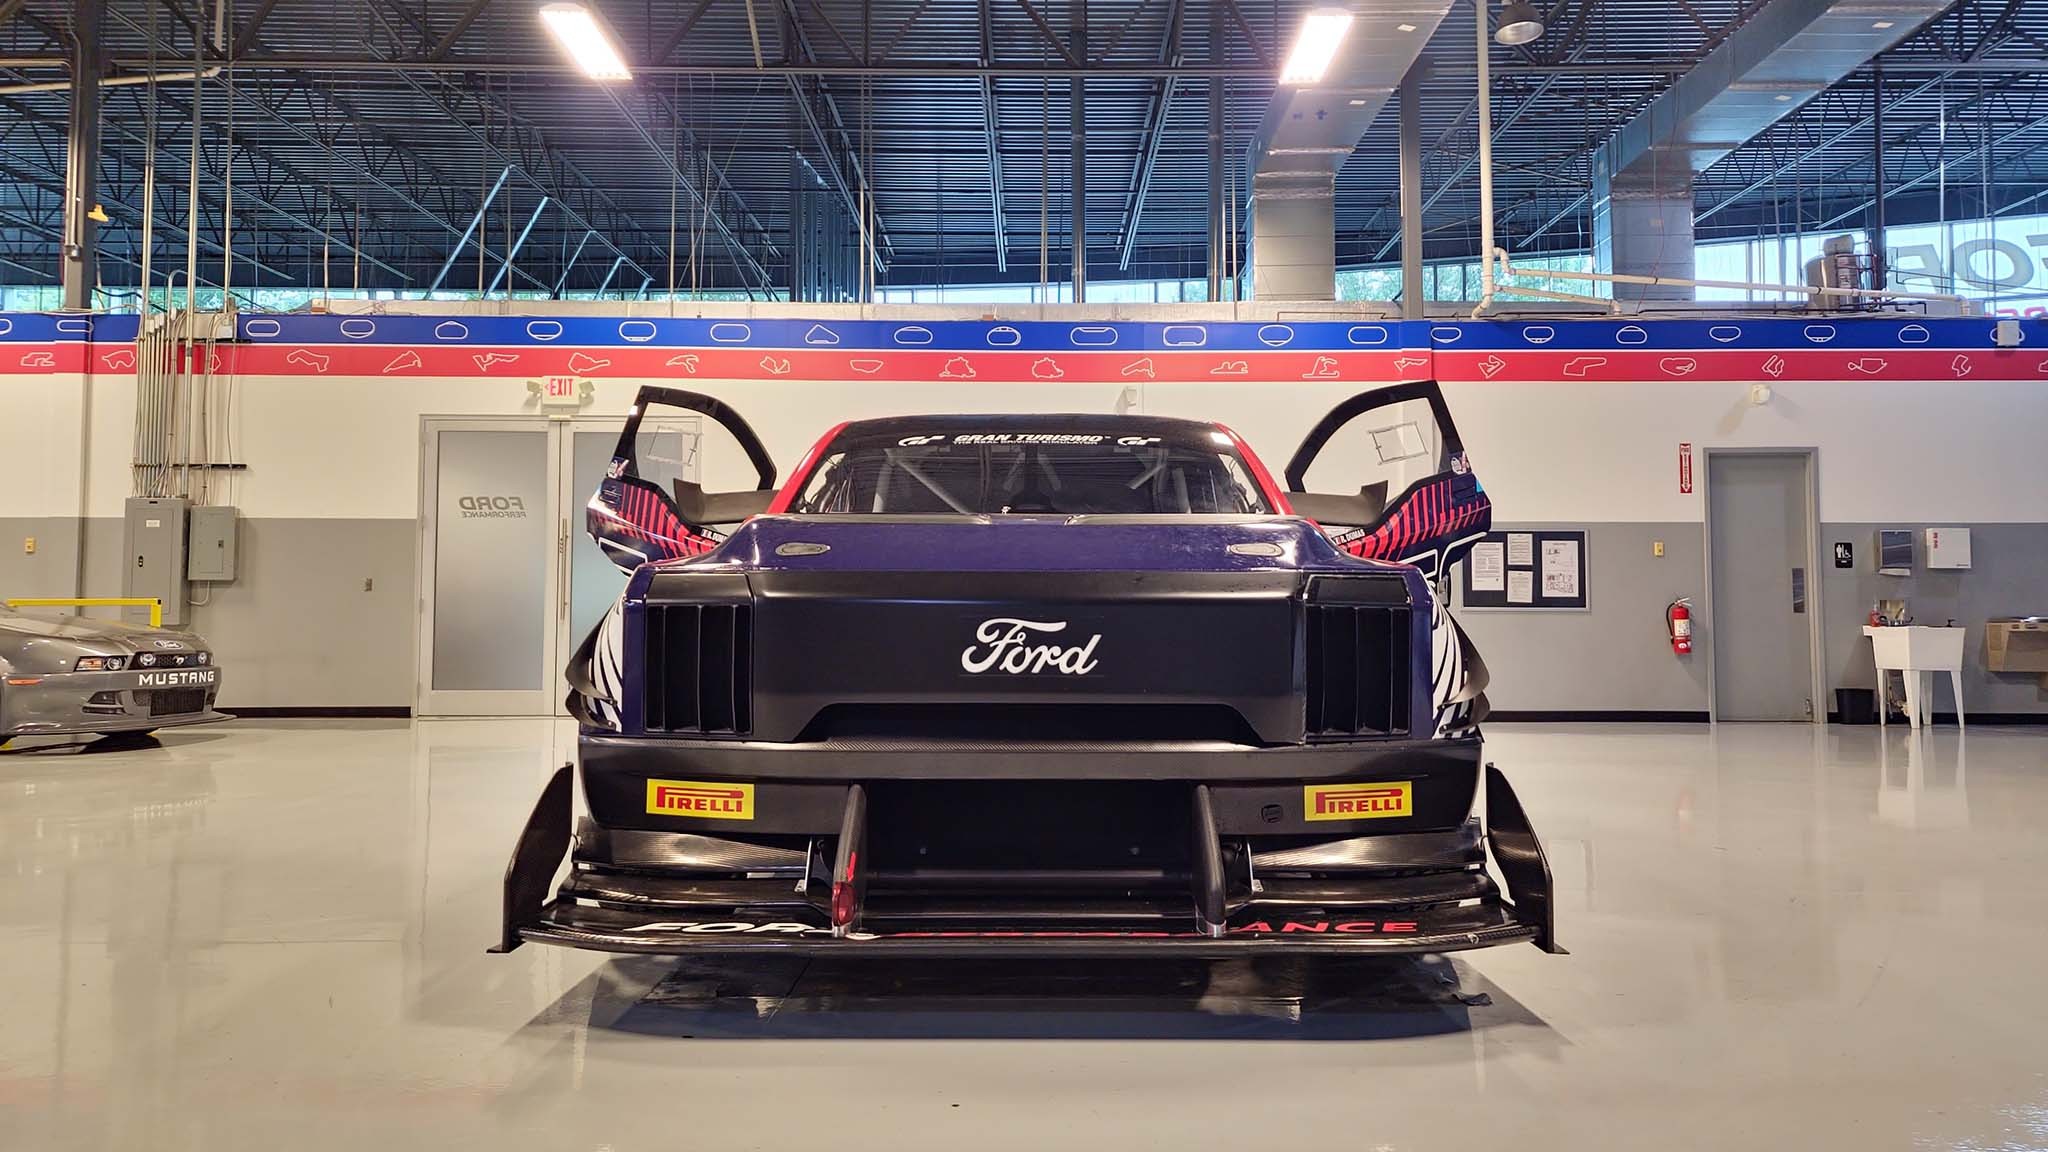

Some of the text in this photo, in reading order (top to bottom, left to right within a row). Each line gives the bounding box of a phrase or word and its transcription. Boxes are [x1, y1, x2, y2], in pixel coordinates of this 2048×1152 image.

[550, 378, 573, 396] EXIT
[954, 434, 1104, 442] GRAN TURISMO
[961, 618, 1102, 675] Ford
[138, 671, 215, 686] MUSTANG
[656, 786, 745, 812] PIRELLI
[1315, 788, 1404, 814] PIRELLI
